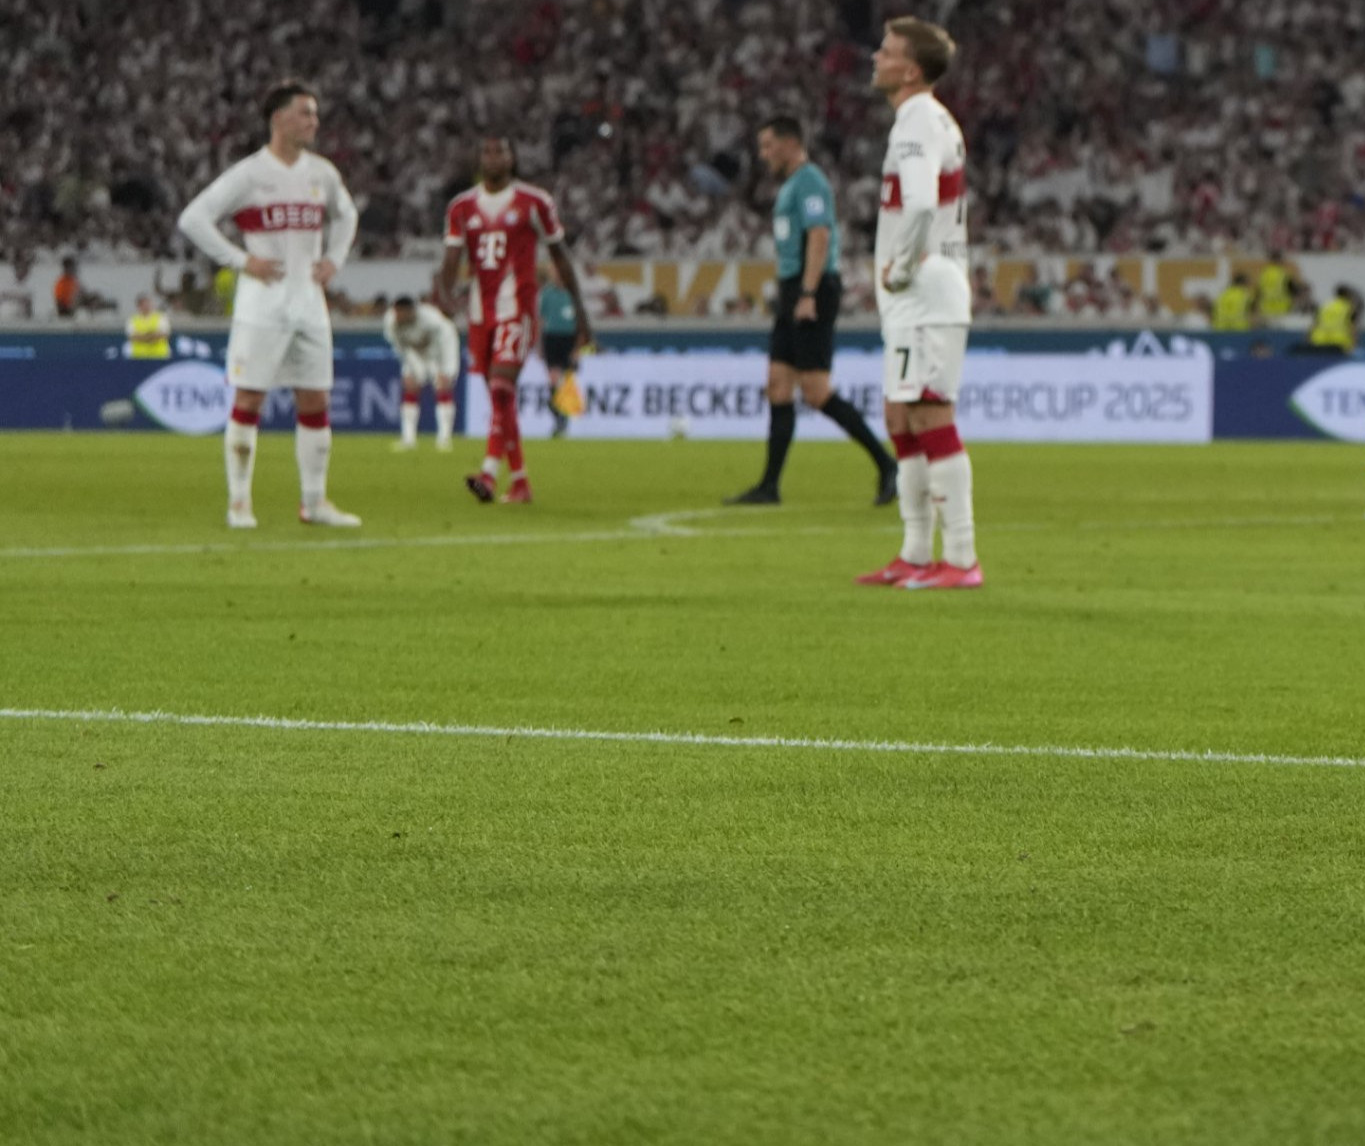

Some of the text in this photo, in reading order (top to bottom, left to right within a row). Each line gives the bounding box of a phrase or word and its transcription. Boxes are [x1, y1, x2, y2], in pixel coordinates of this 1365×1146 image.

[477, 230, 507, 270] T
[896, 347, 909, 380] 7
[518, 382, 629, 417] FRNZ
[958, 383, 1097, 421] PERCUP
[1104, 383, 1192, 421] 2025
